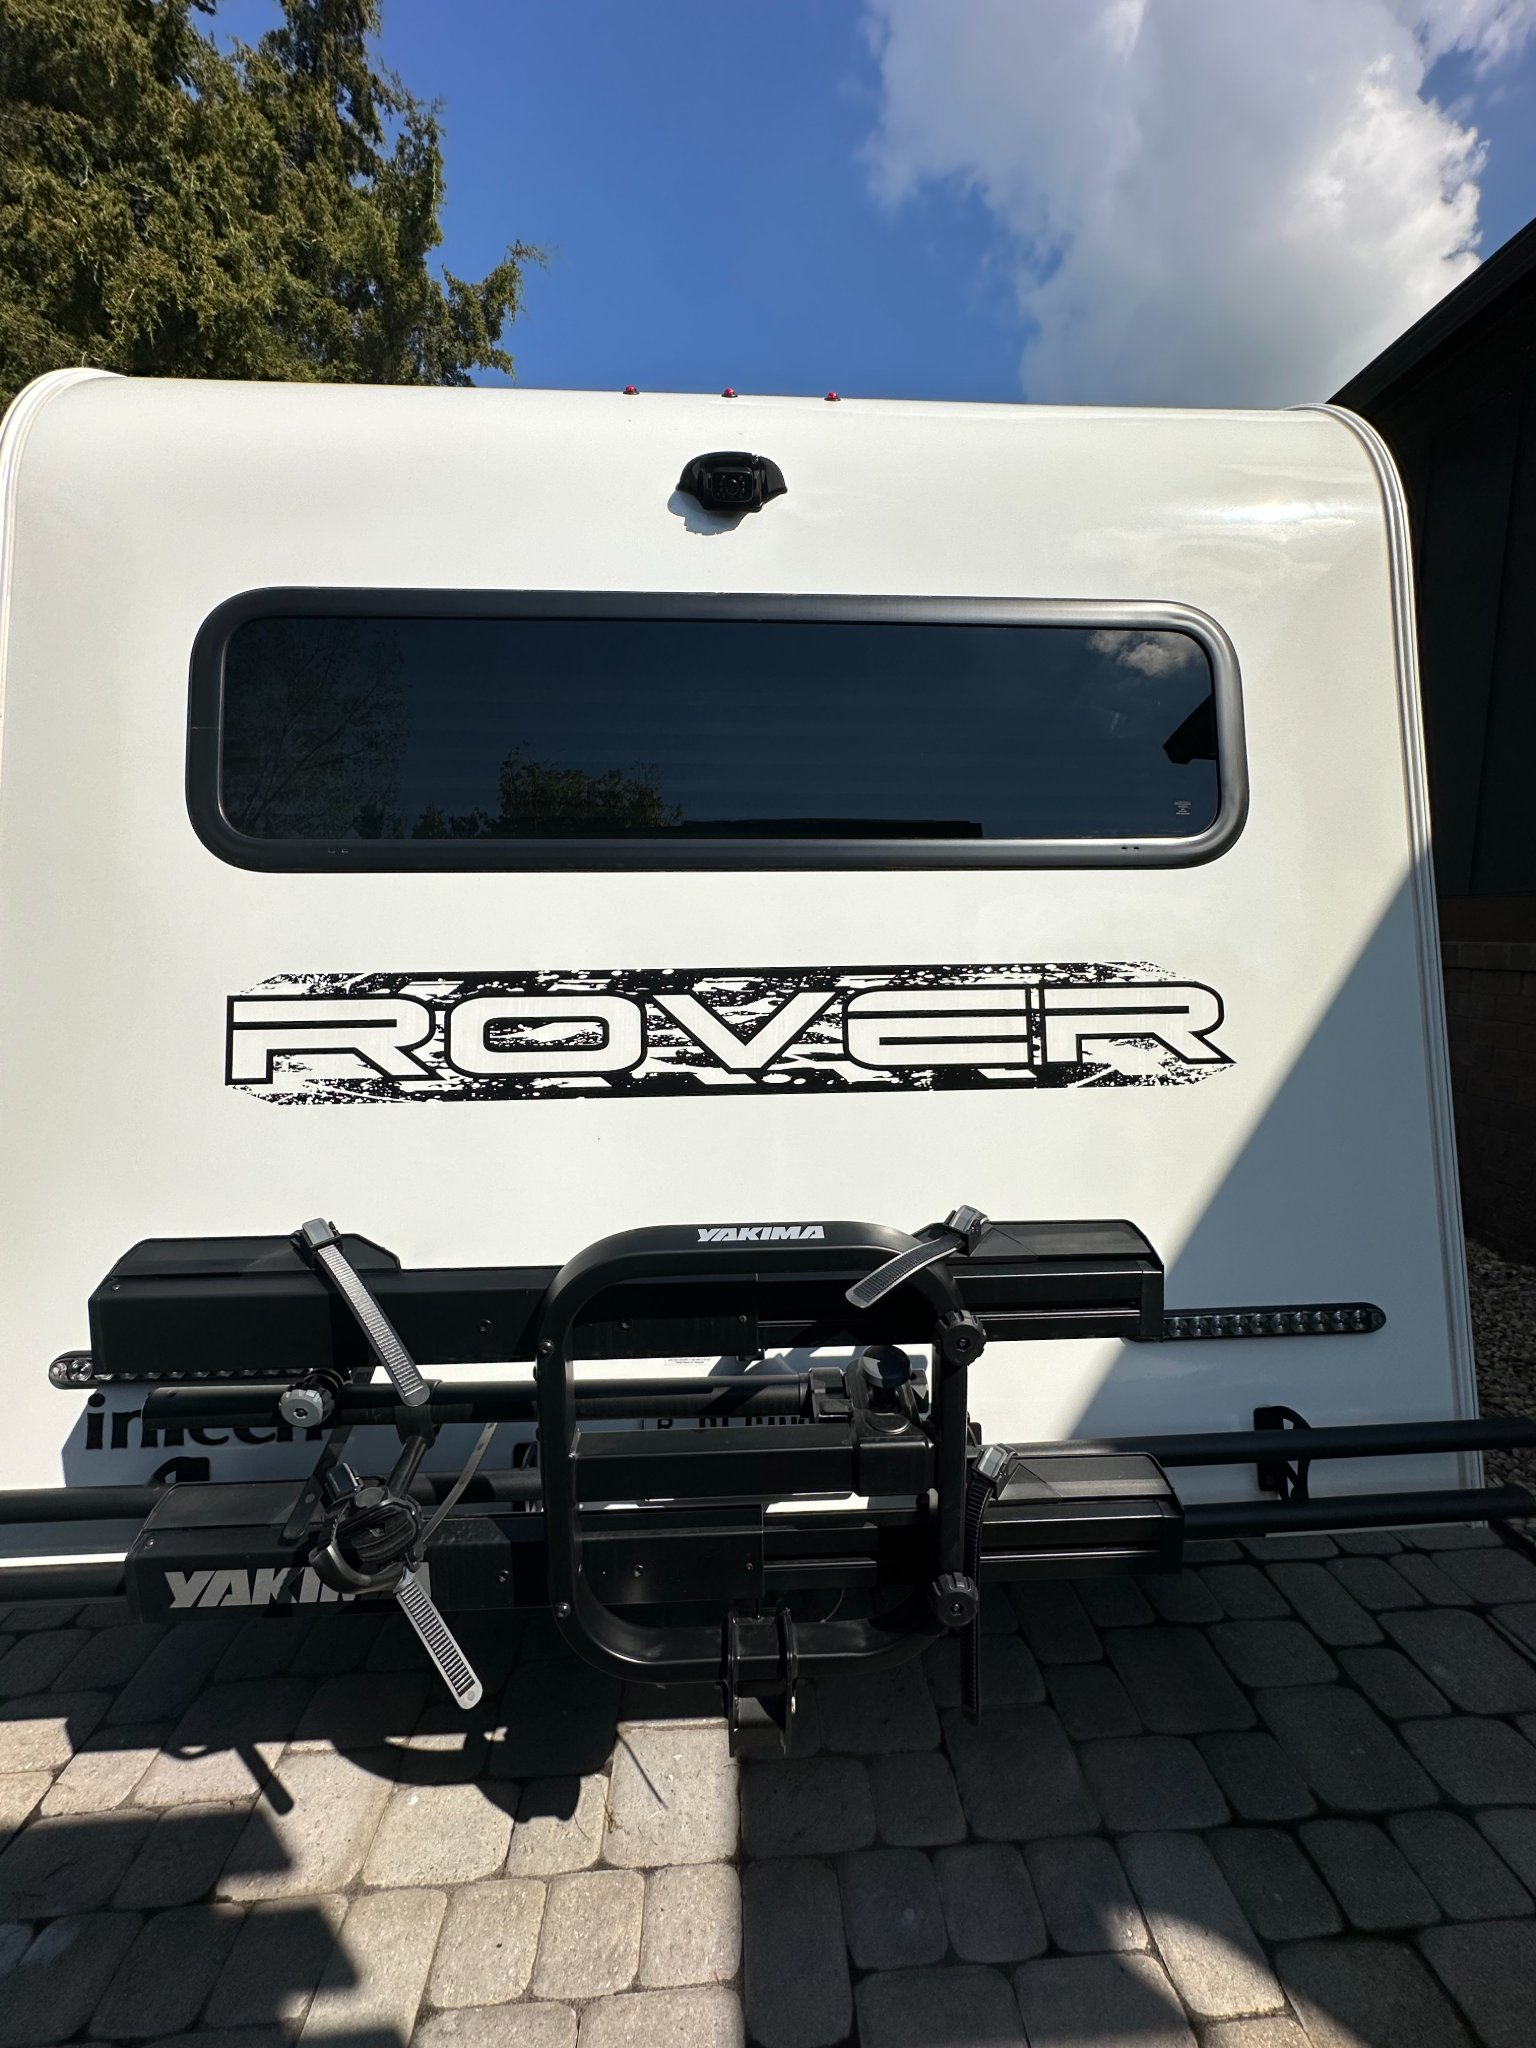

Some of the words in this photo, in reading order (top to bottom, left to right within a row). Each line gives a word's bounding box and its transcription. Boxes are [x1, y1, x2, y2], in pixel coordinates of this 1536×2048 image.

[225, 980, 1237, 1085] ROVER
[697, 1225, 826, 1243] YAKIMA
[164, 1562, 432, 1608] YAKI
